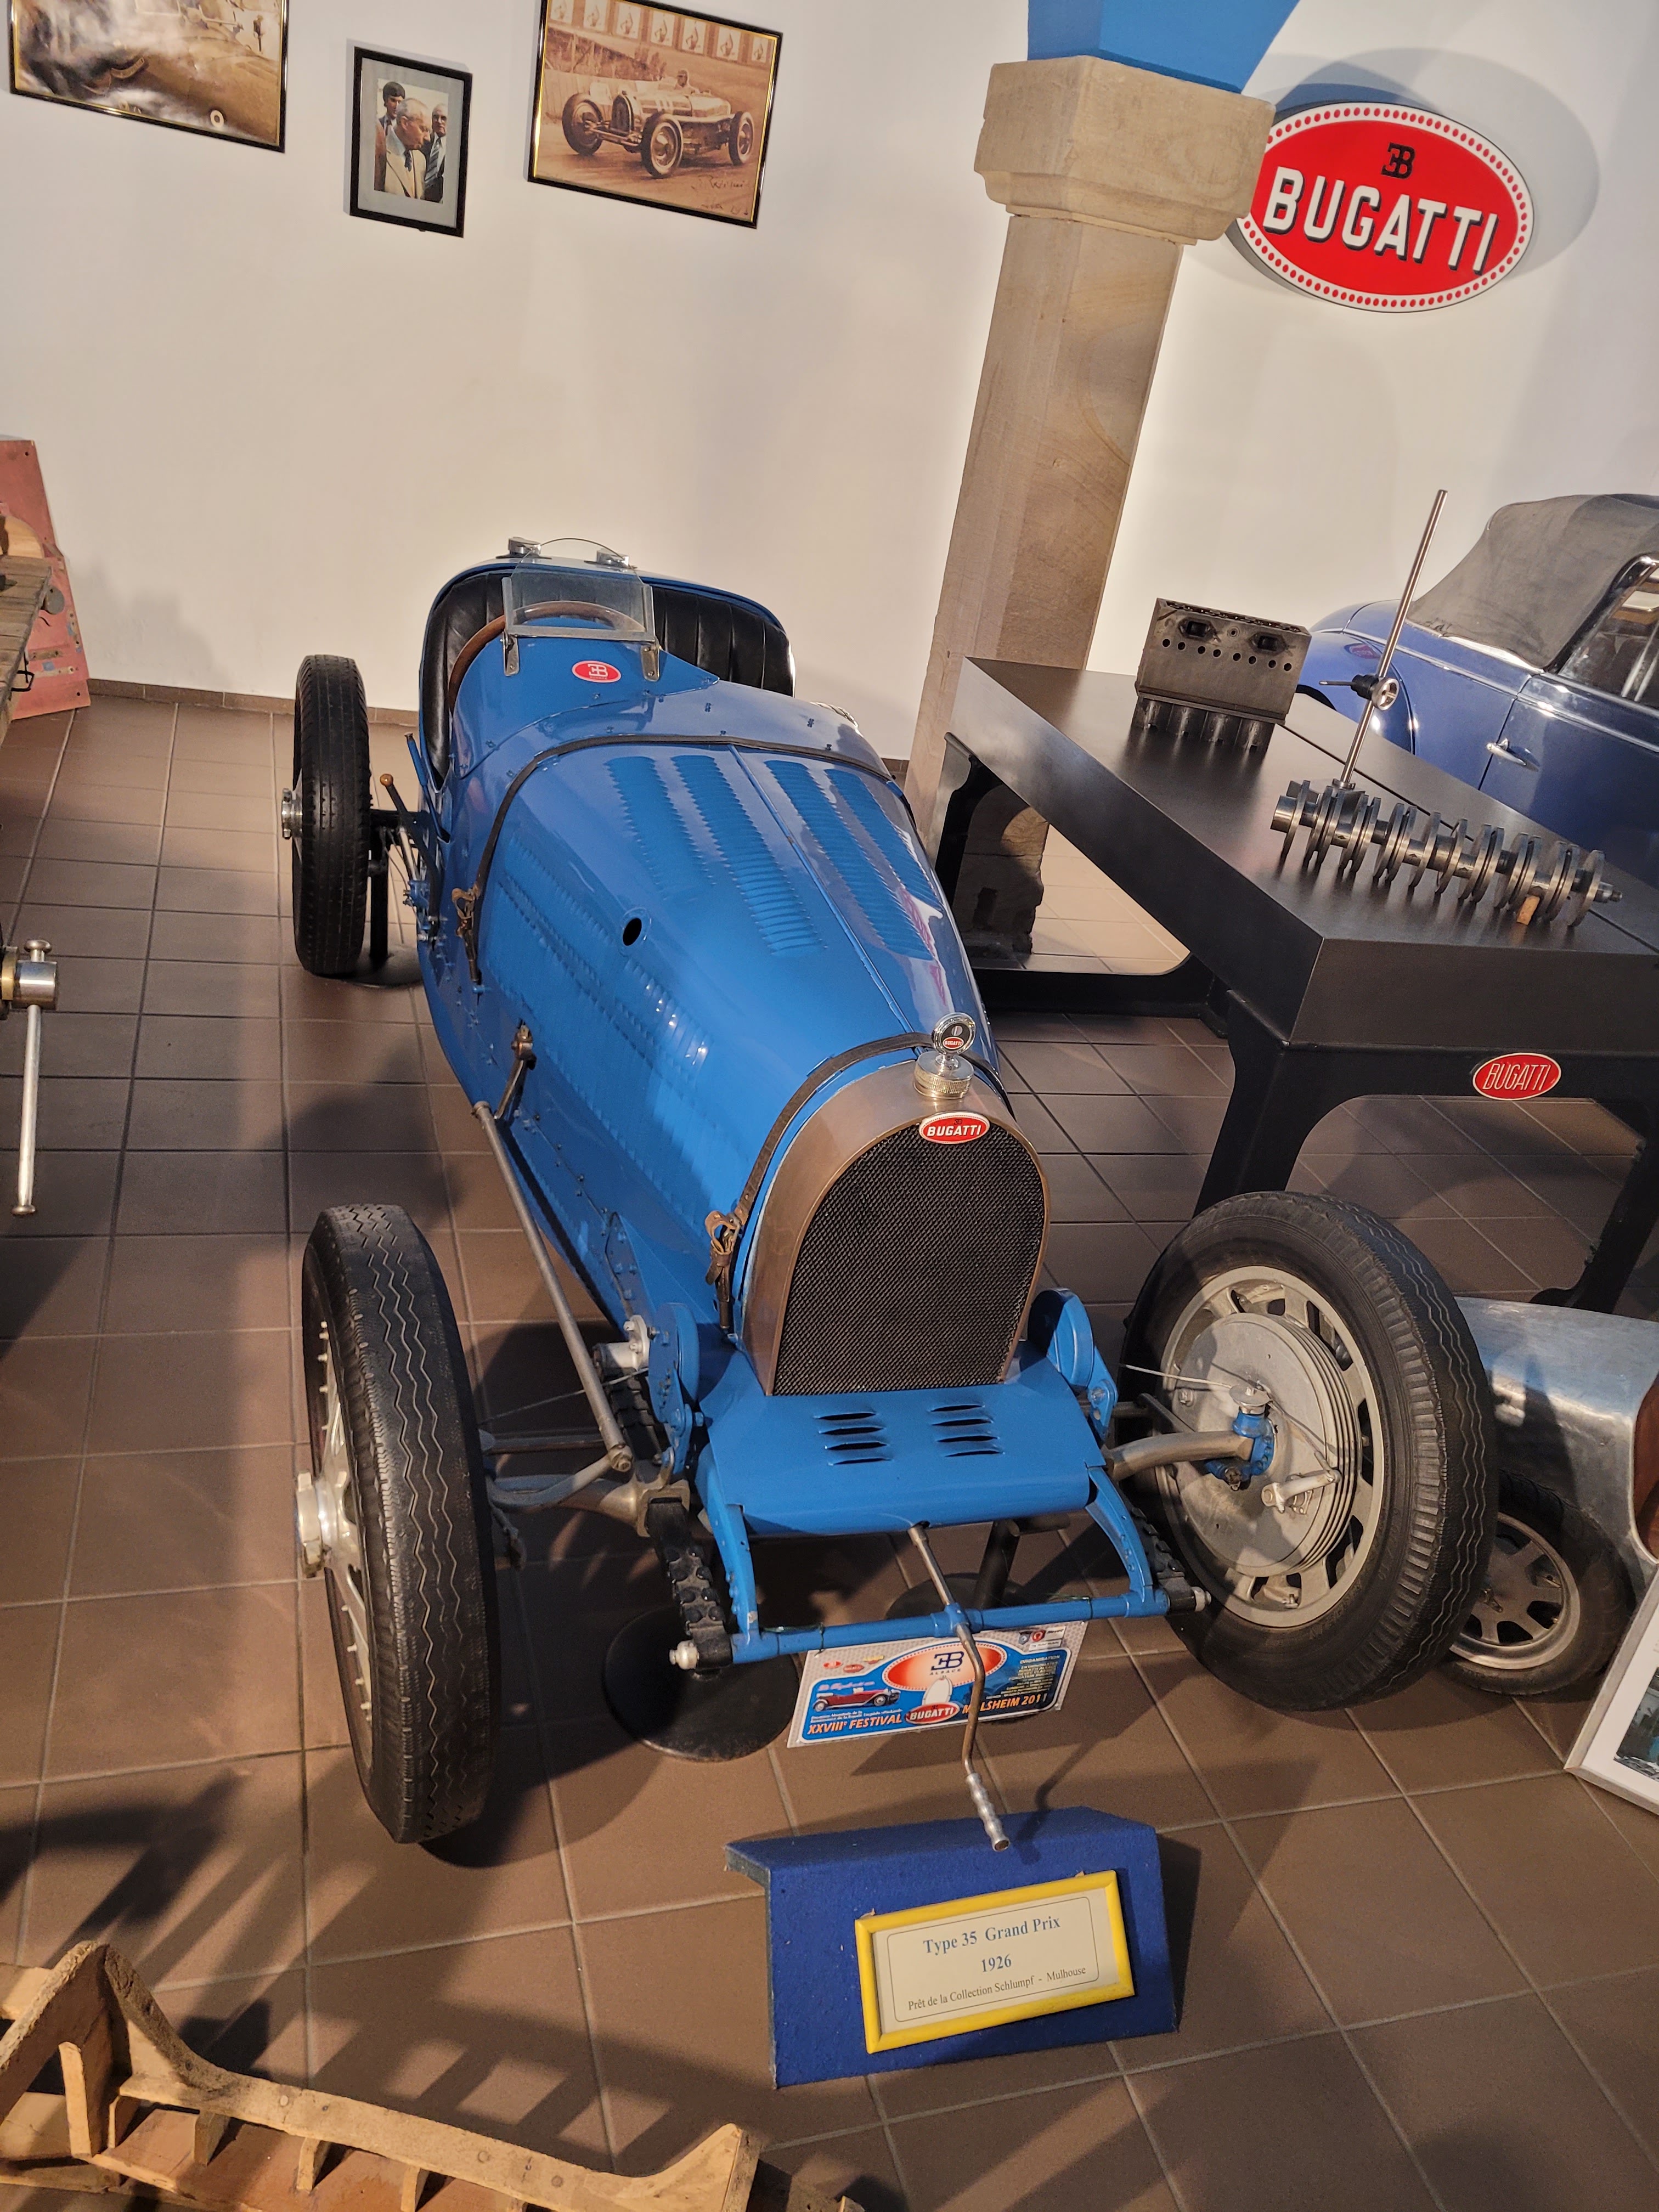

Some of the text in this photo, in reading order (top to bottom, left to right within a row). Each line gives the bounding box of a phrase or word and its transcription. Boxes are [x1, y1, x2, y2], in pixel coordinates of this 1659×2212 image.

[1263, 166, 1498, 275] BUGATTI
[1482, 1063, 1551, 1091] BUGATTI
[927, 1125, 982, 1137] BUGATTI
[849, 1713, 903, 1730] FESTIVAL
[910, 1707, 954, 1720] BUGATTI
[962, 1697, 1021, 1714] MLSHEIM
[923, 1916, 1061, 1956] Type 35 Grand Prix
[981, 1953, 1012, 1973] 1926
[908, 1999, 926, 2011] Prêt
[928, 1996, 938, 2006] de
[940, 1994, 948, 2004] la
[950, 1986, 993, 2001] Collection
[994, 1975, 1035, 1992] Schlumpf
[1046, 1967, 1086, 1982] Mulhouse
